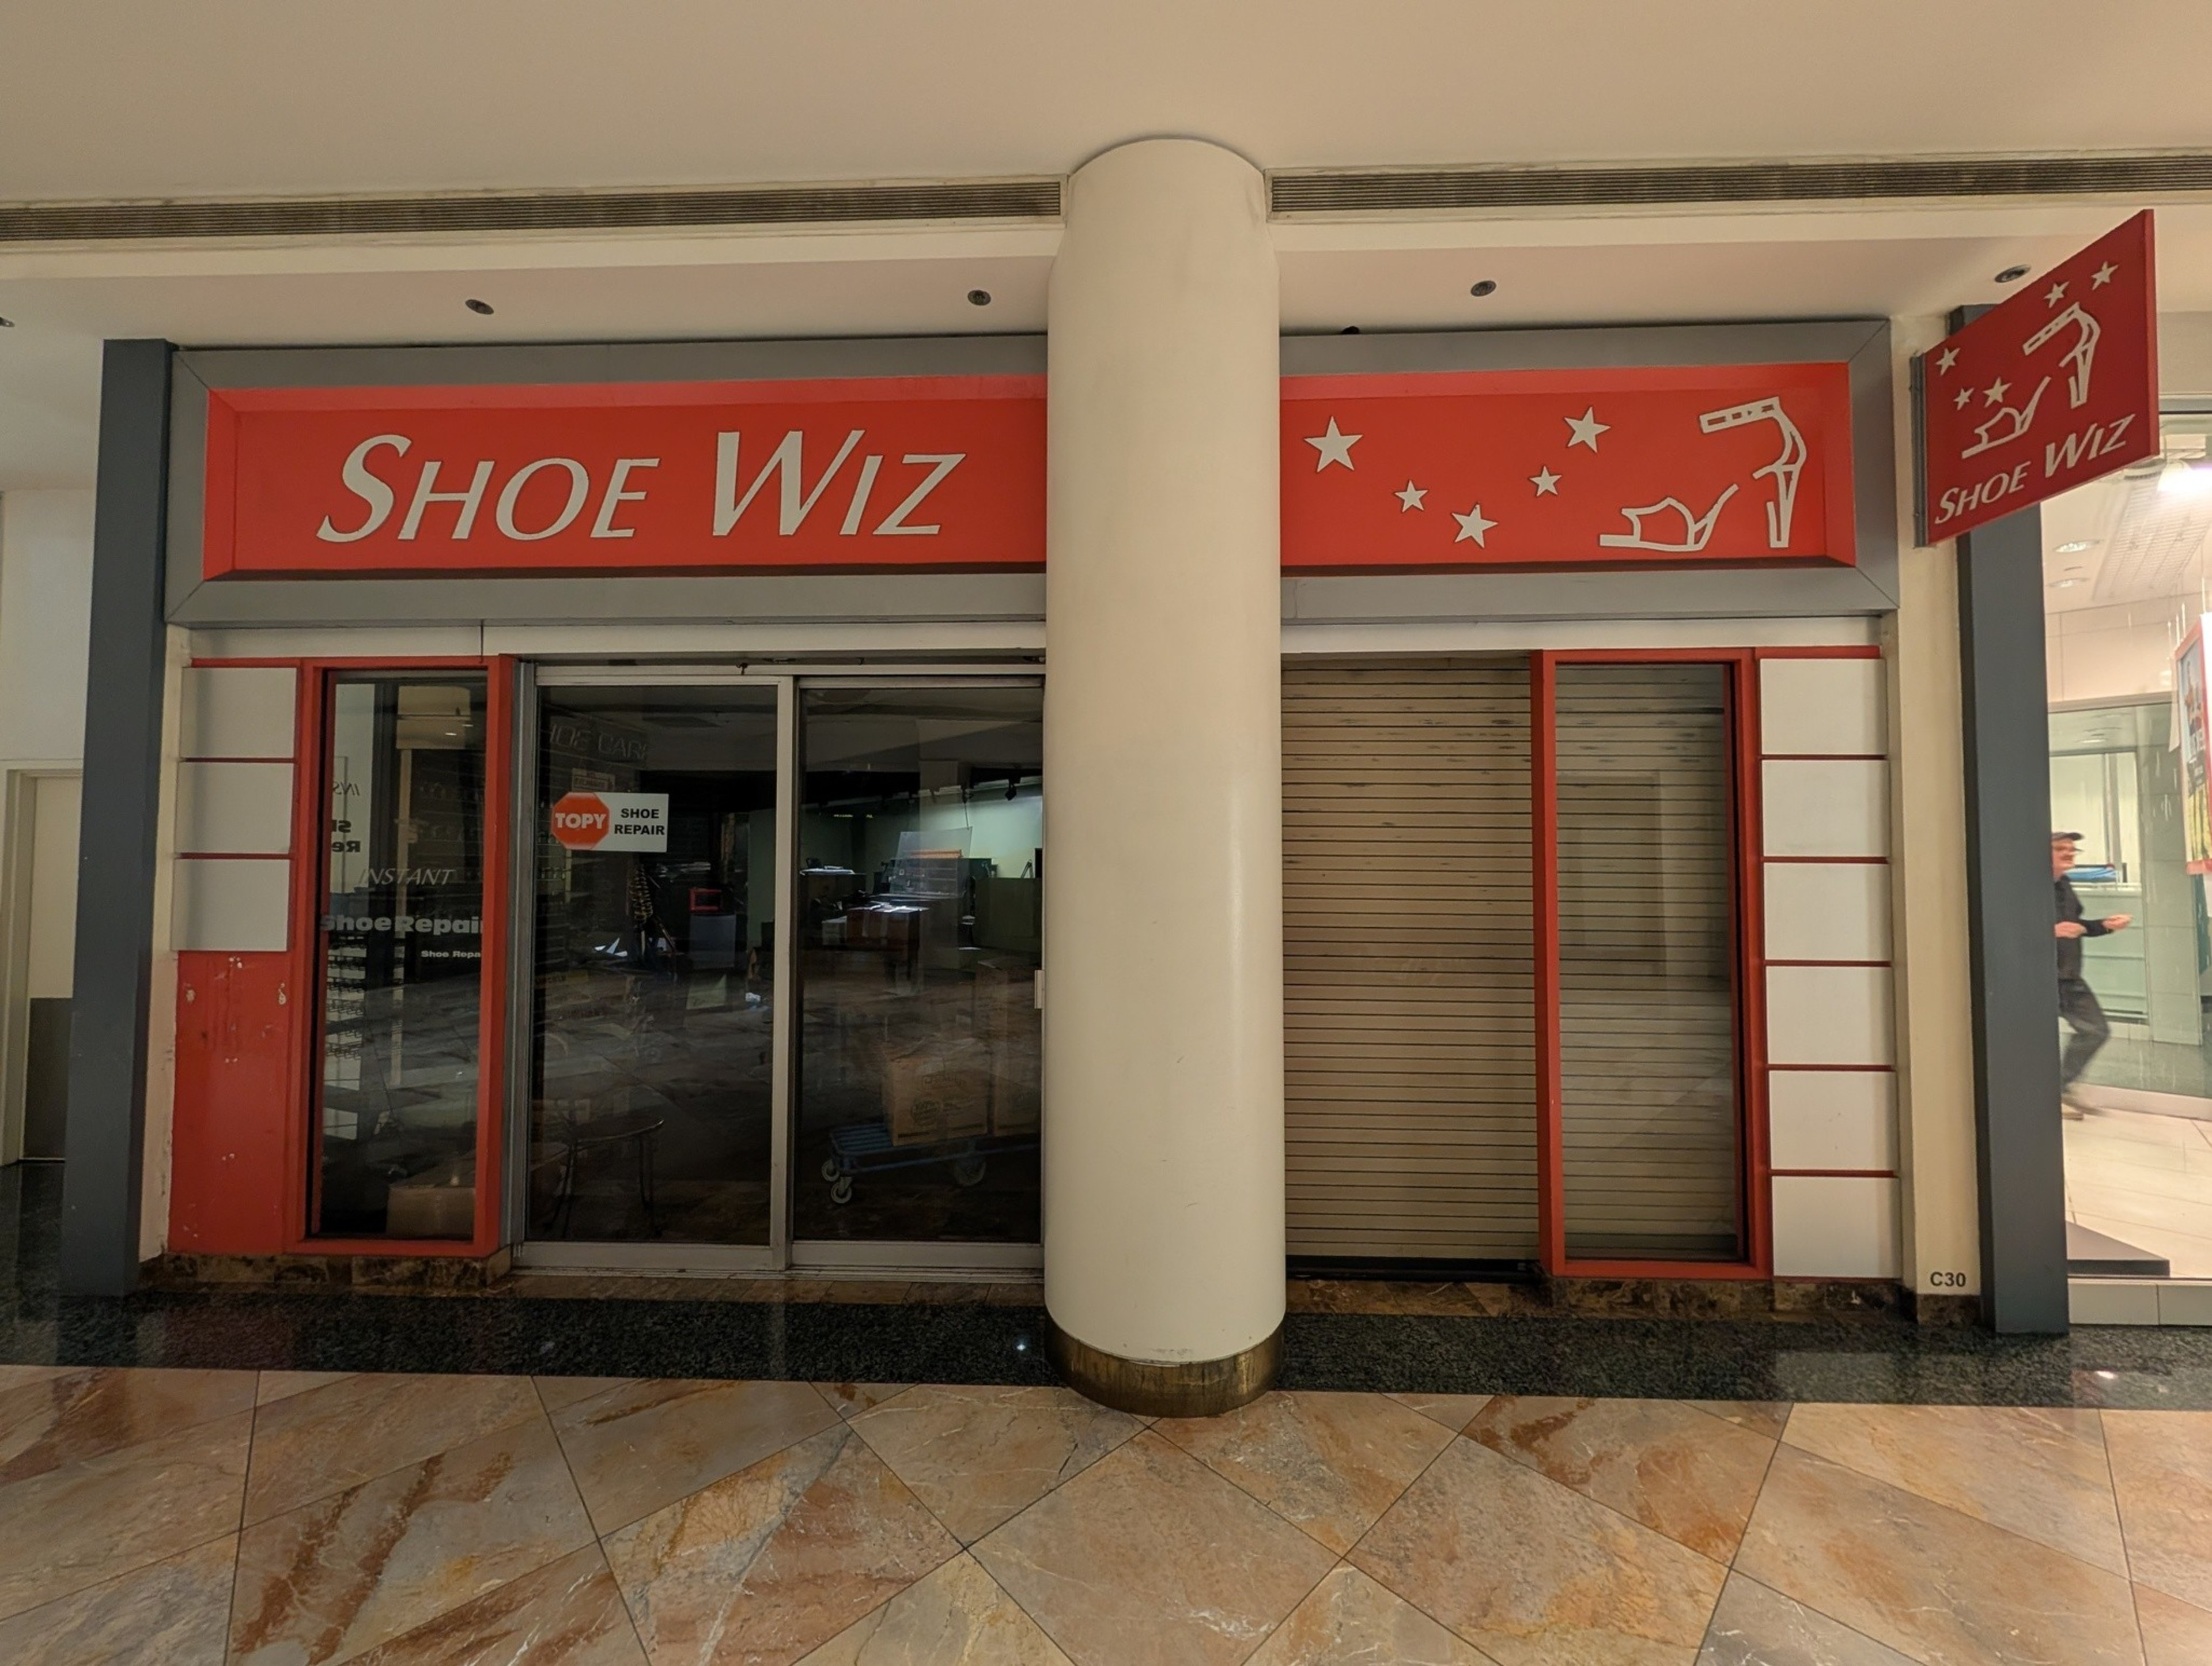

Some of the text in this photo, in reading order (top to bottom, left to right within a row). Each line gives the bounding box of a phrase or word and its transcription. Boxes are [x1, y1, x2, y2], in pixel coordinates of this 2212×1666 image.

[1934, 413, 2135, 525] SHOE WIZ
[316, 429, 967, 542] SHOE WIZ
[555, 813, 607, 829] TOPY
[621, 808, 660, 819] SHOE
[614, 824, 666, 836] REPAIR
[358, 868, 456, 885] INSTANT
[320, 915, 392, 931] Shoe
[1930, 1271, 1967, 1287] C30
